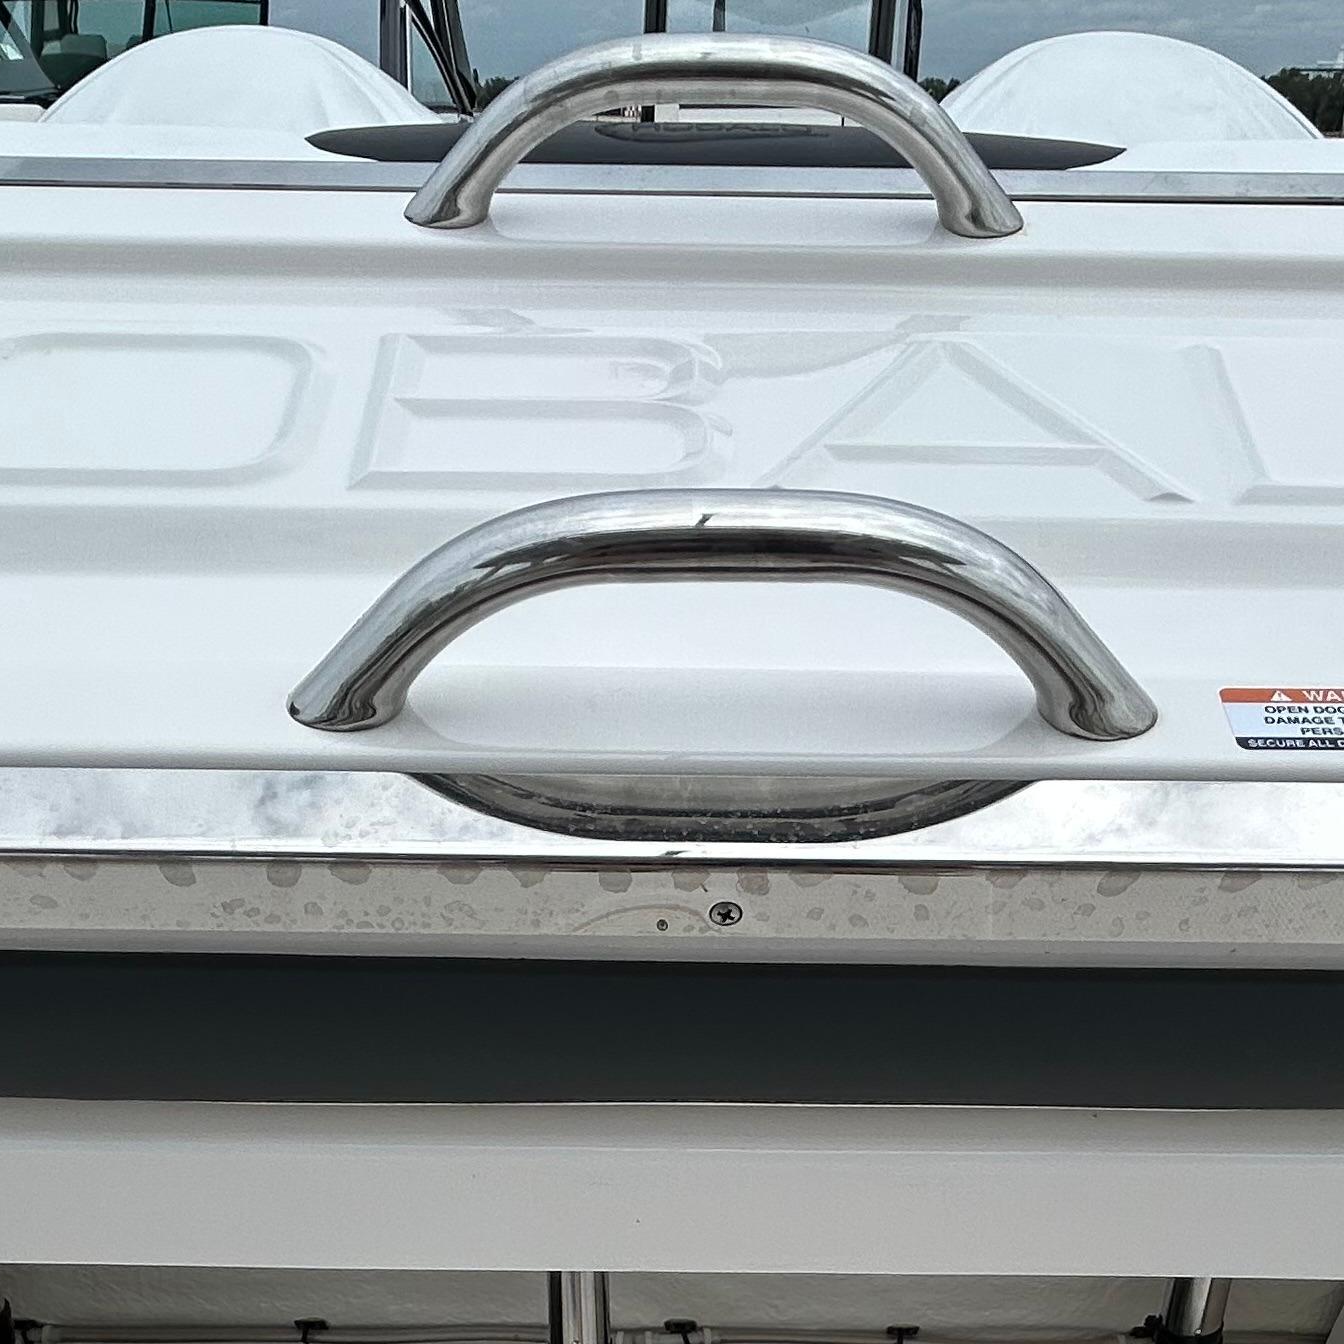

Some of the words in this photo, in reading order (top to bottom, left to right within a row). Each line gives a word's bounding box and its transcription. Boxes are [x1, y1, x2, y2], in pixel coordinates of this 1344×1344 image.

[1264, 705, 1310, 714] OPEN
[1264, 716, 1336, 725] DAMAGE
[1247, 738, 1306, 748] SECURE
[1308, 739, 1336, 748] ALL
